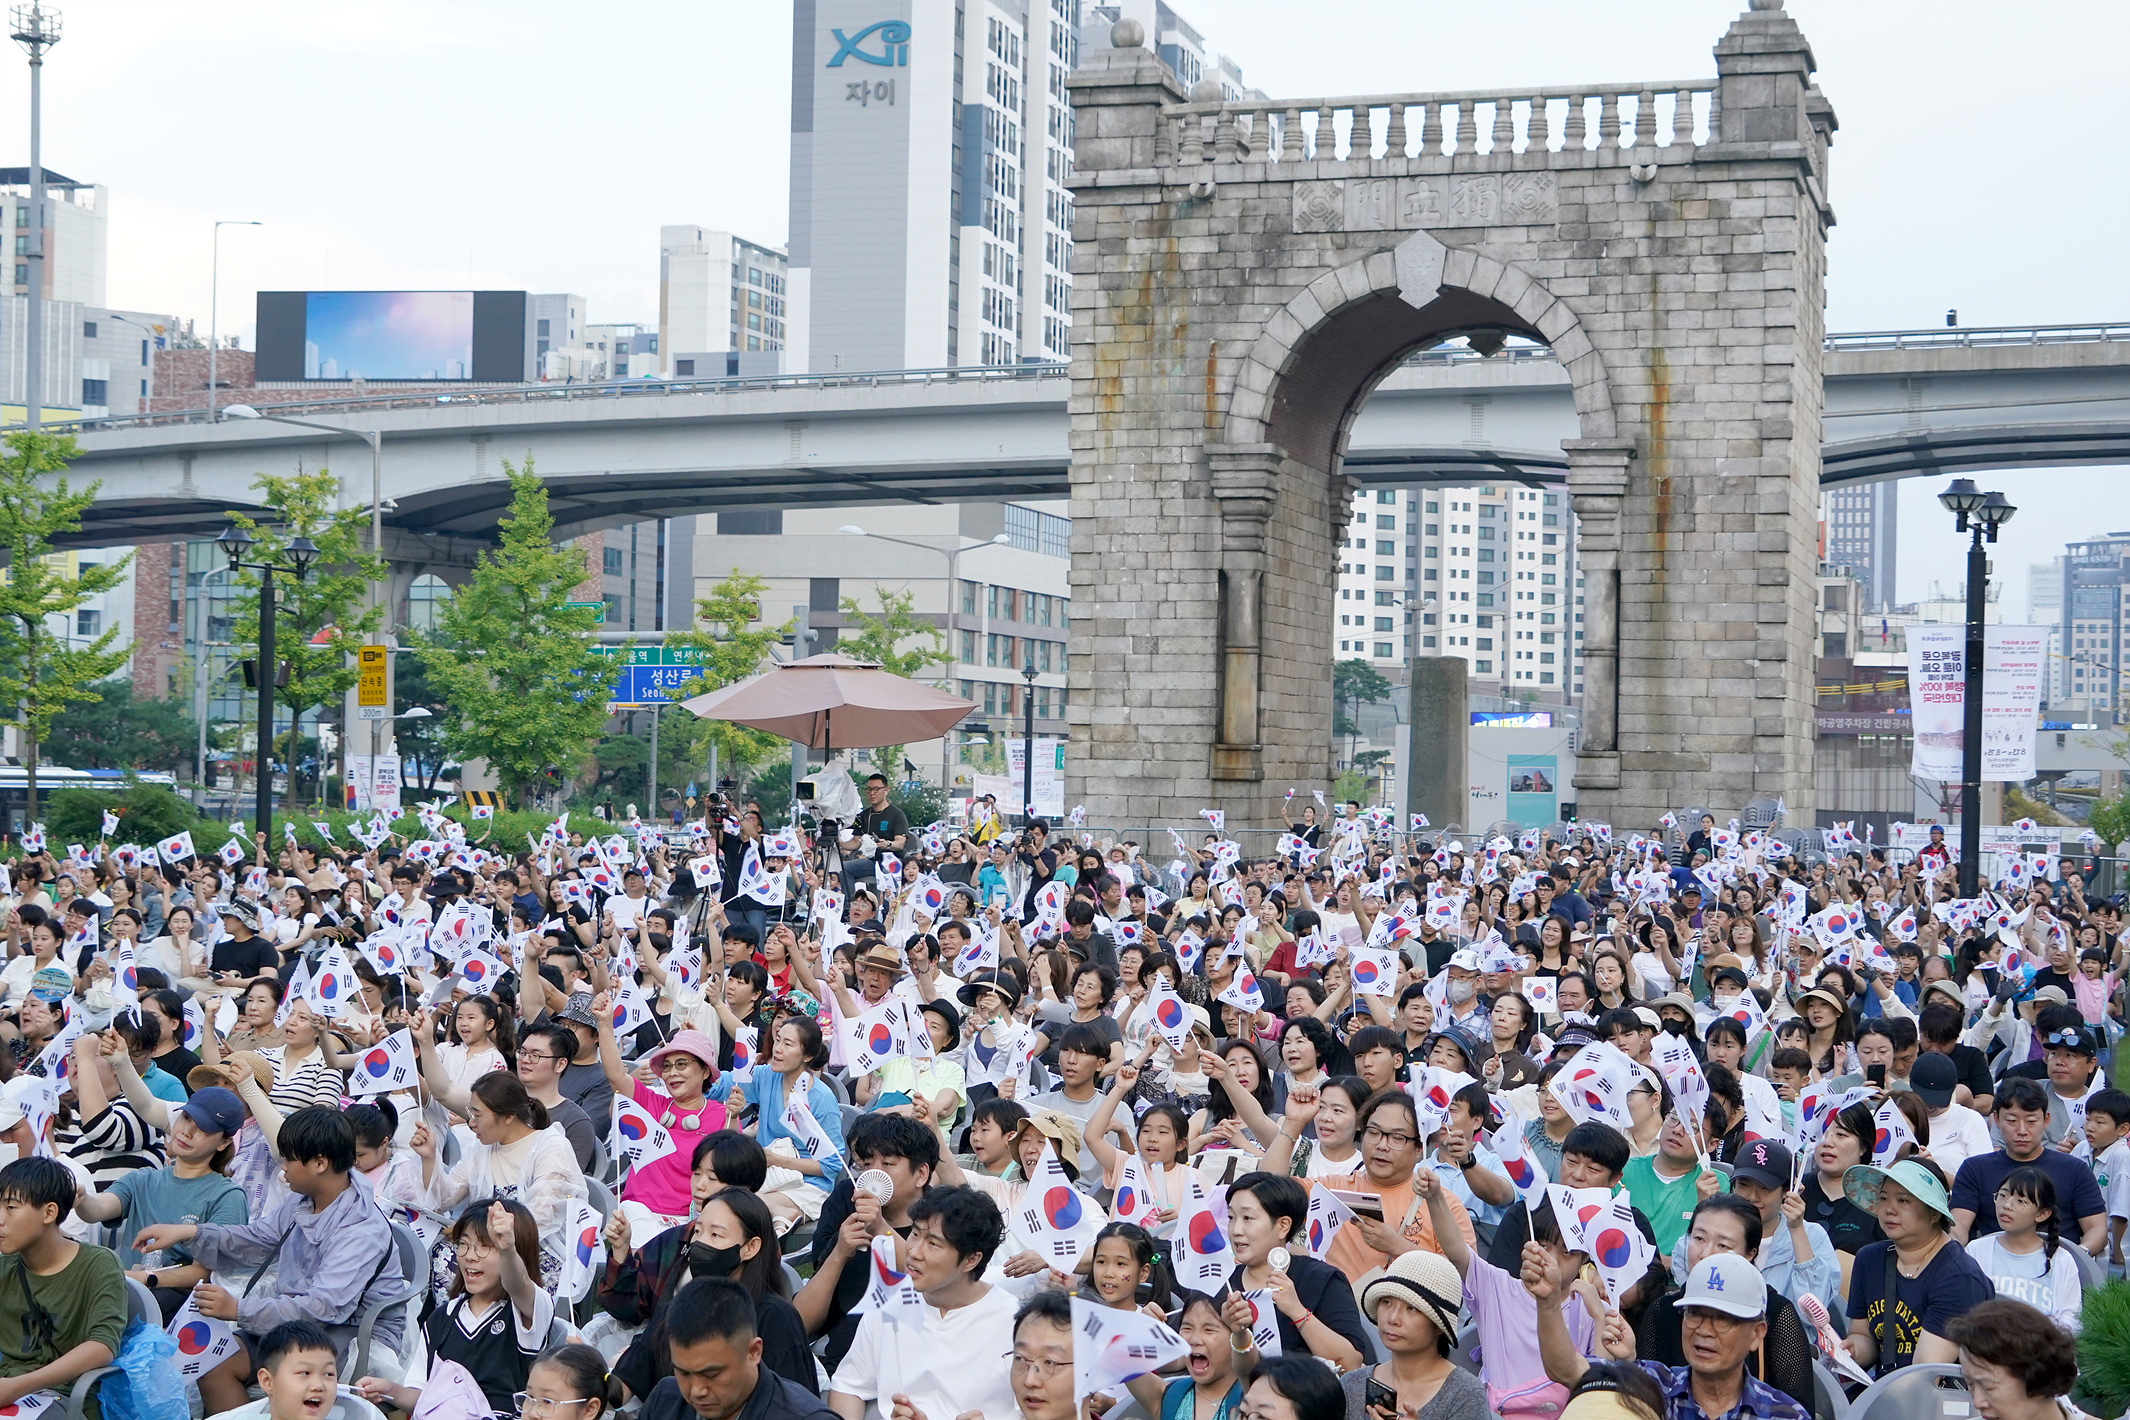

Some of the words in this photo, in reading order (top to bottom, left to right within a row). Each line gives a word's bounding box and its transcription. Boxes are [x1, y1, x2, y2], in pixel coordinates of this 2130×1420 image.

[846, 79, 895, 107] 자이
[651, 669, 692, 685] 성산로
[363, 708, 382, 718] 300m
[1815, 717, 1871, 729] 하공영주차장
[1874, 718, 1910, 729] 건립공사
[1707, 1266, 1725, 1291] LA
